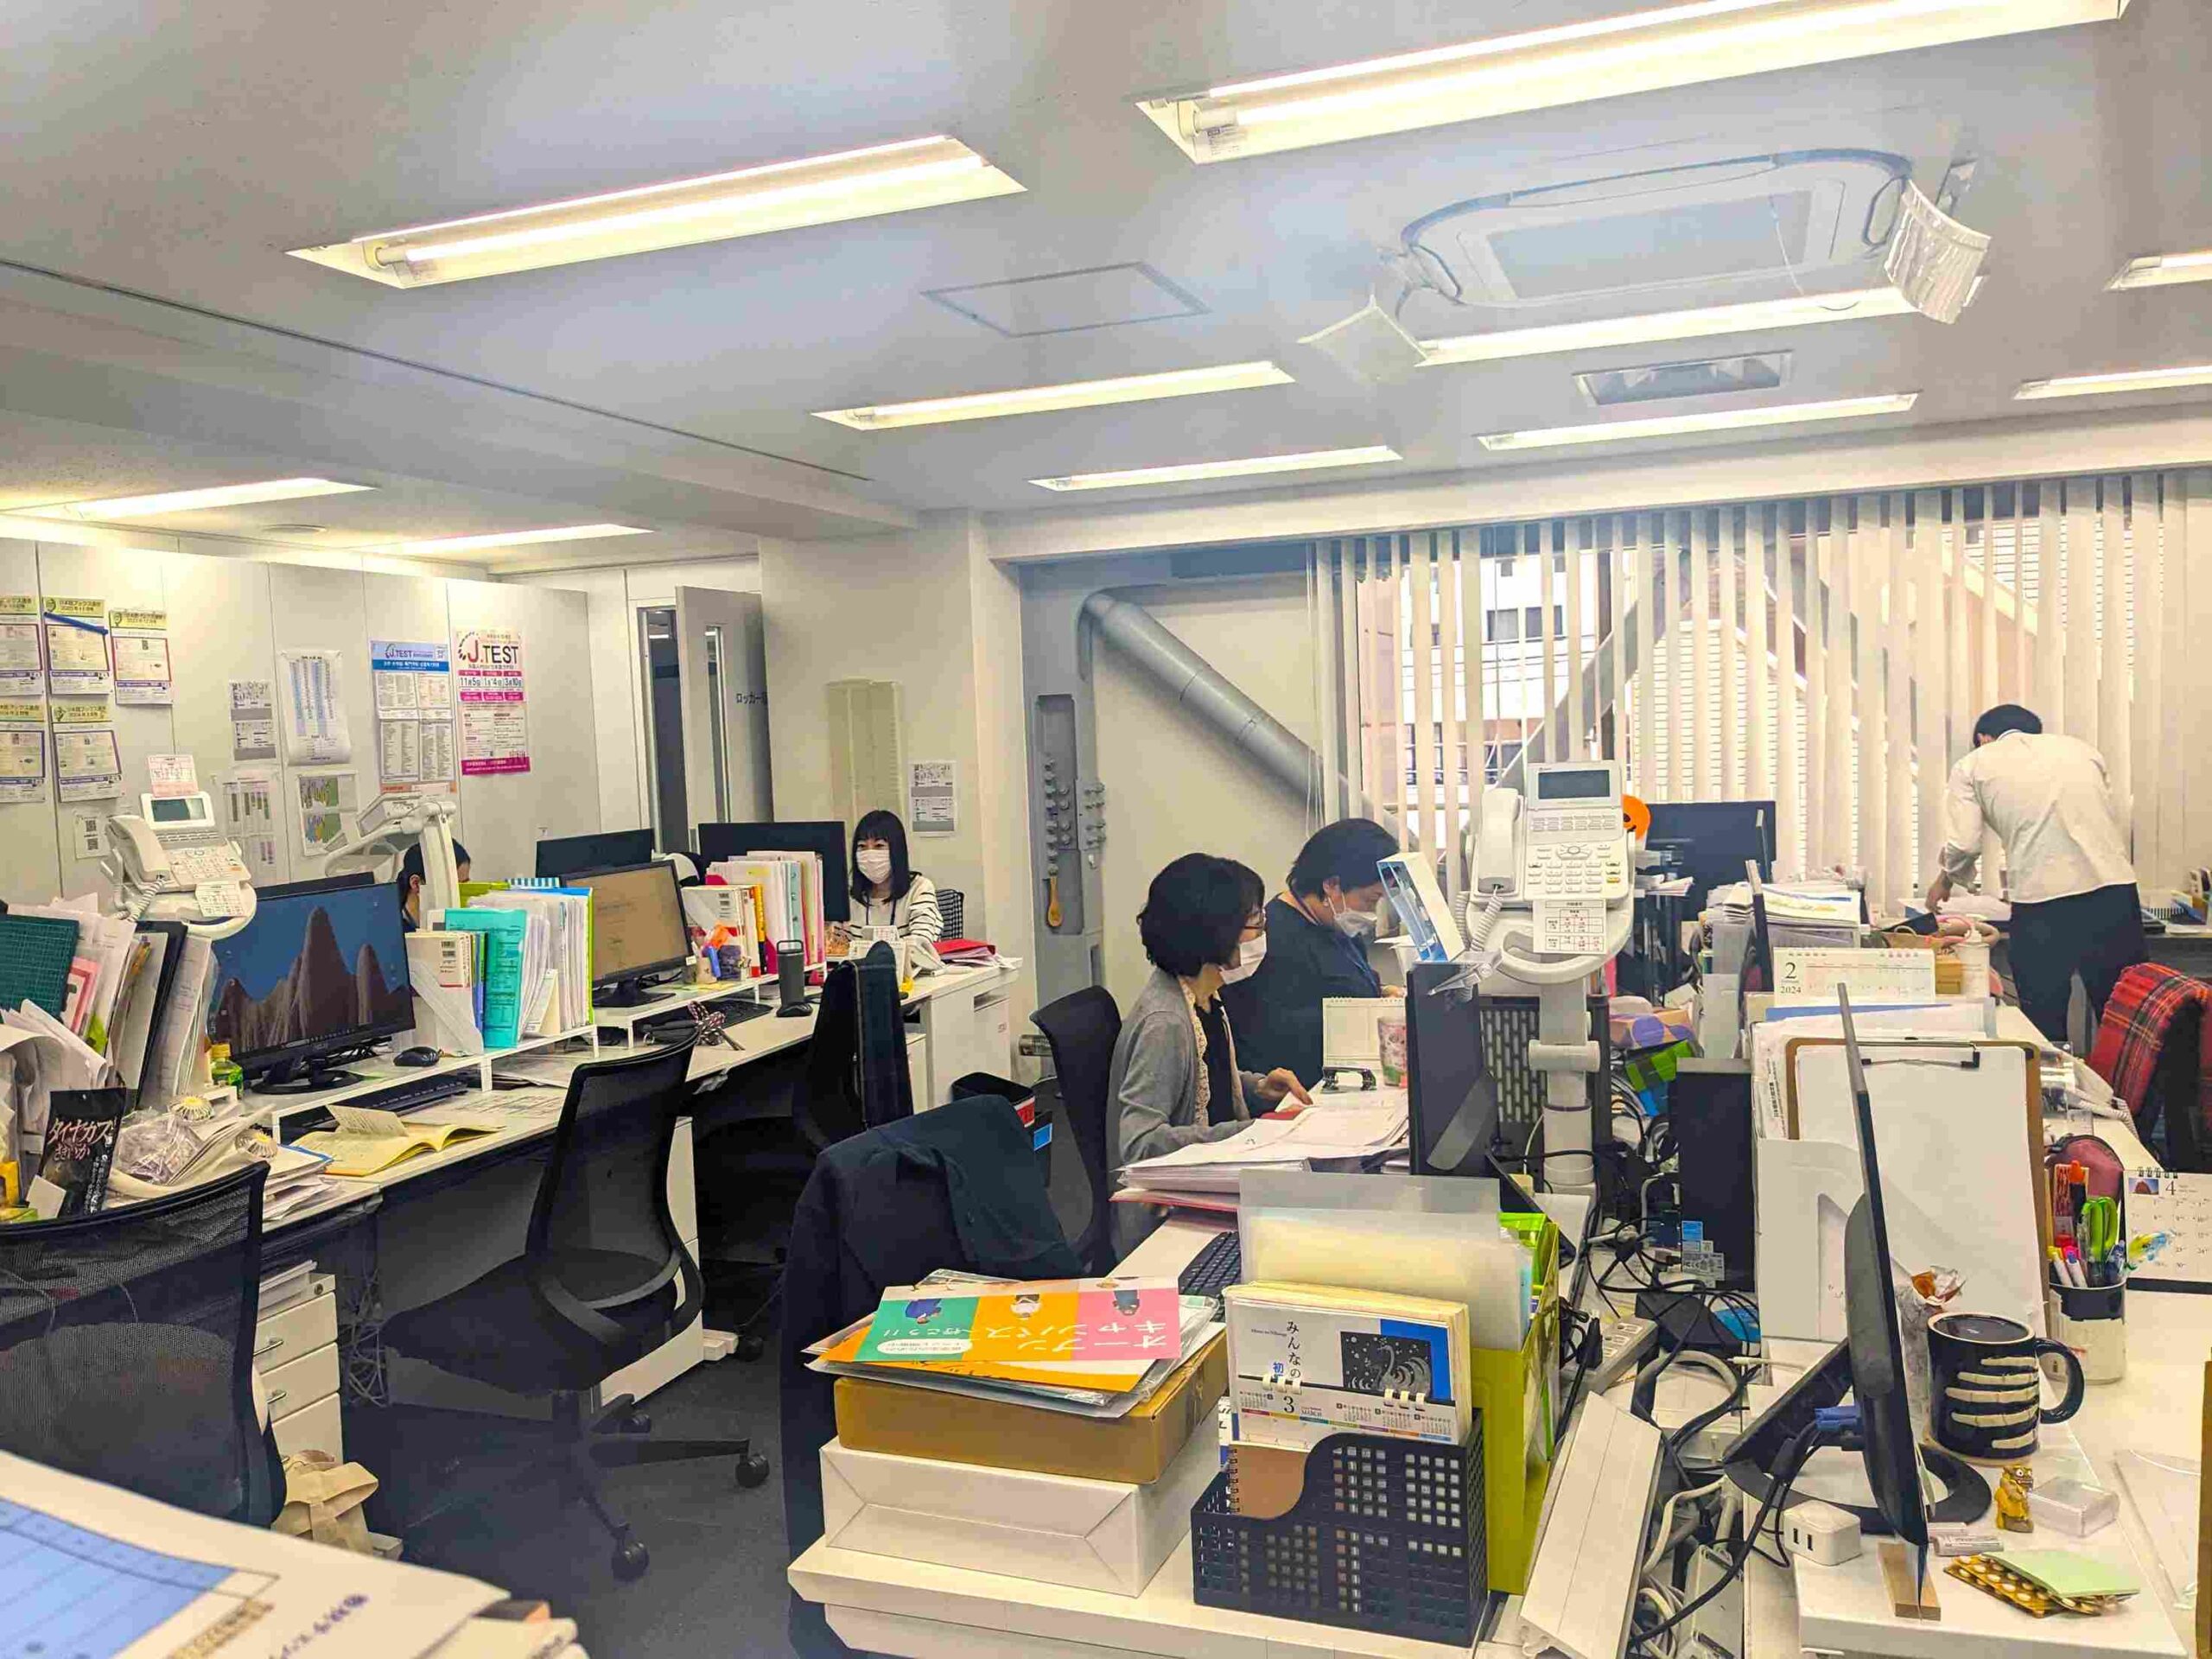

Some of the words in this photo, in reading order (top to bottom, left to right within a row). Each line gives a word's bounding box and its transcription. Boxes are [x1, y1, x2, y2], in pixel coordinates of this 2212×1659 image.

[467, 639, 519, 664] J.TEST
[1785, 962, 1797, 979] 2
[1780, 985, 1802, 994] 2024
[2165, 1179, 2177, 1196] 4
[1017, 1335, 1167, 1354] オープン
[1286, 1321, 1302, 1378] みんなの
[1283, 1395, 1295, 1414] 3
